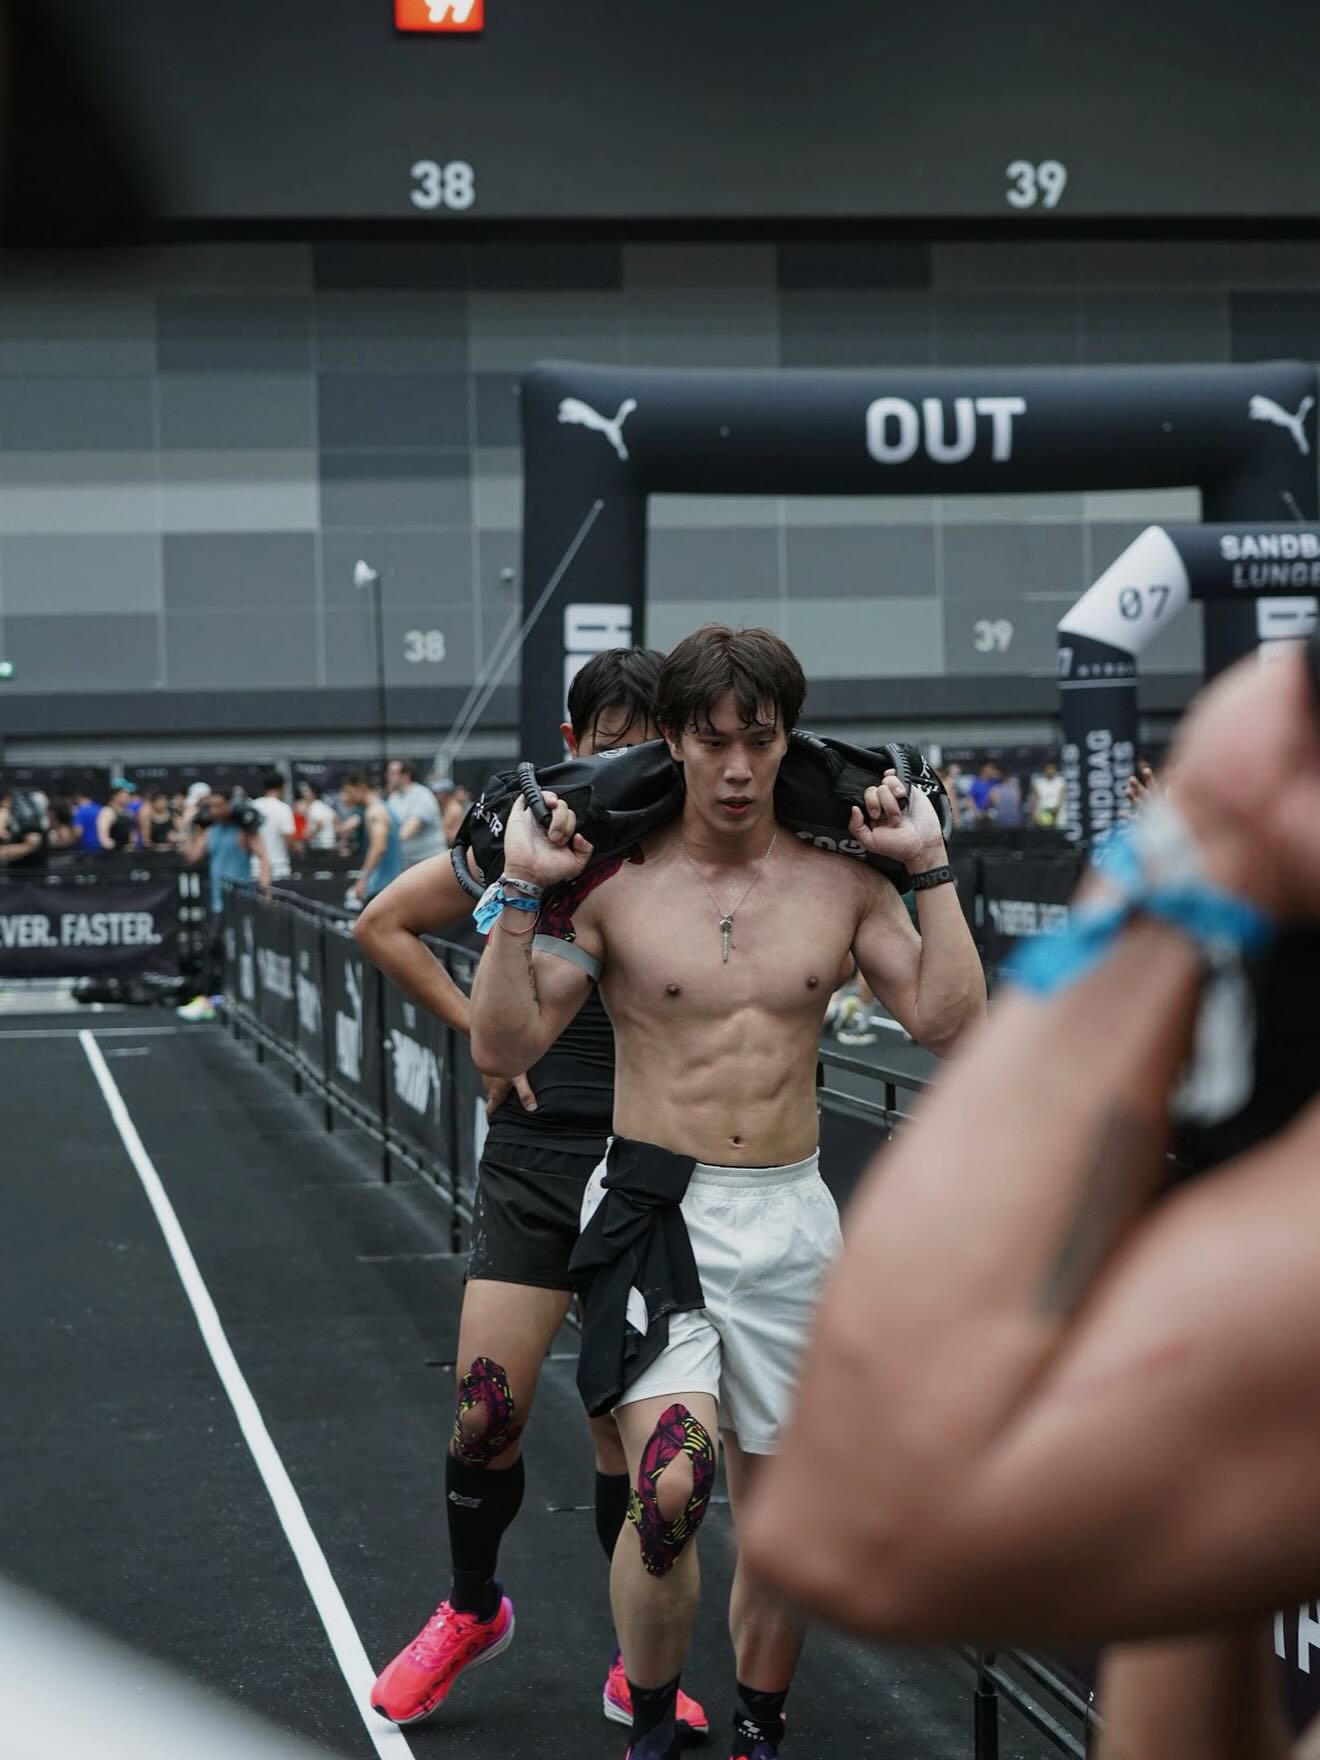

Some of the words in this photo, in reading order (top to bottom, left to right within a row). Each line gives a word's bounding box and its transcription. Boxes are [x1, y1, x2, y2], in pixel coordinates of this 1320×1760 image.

[410, 160, 475, 210] 38
[1006, 160, 1067, 209] 39
[865, 397, 1027, 464] OUT
[1219, 533, 1320, 561] SANDB
[1118, 584, 1170, 621] 07
[403, 629, 446, 663] 38
[974, 619, 1014, 652] 39
[1085, 729, 1115, 846] ANDBAG
[0, 914, 58, 947] VER.
[61, 912, 163, 946] FASTER.
